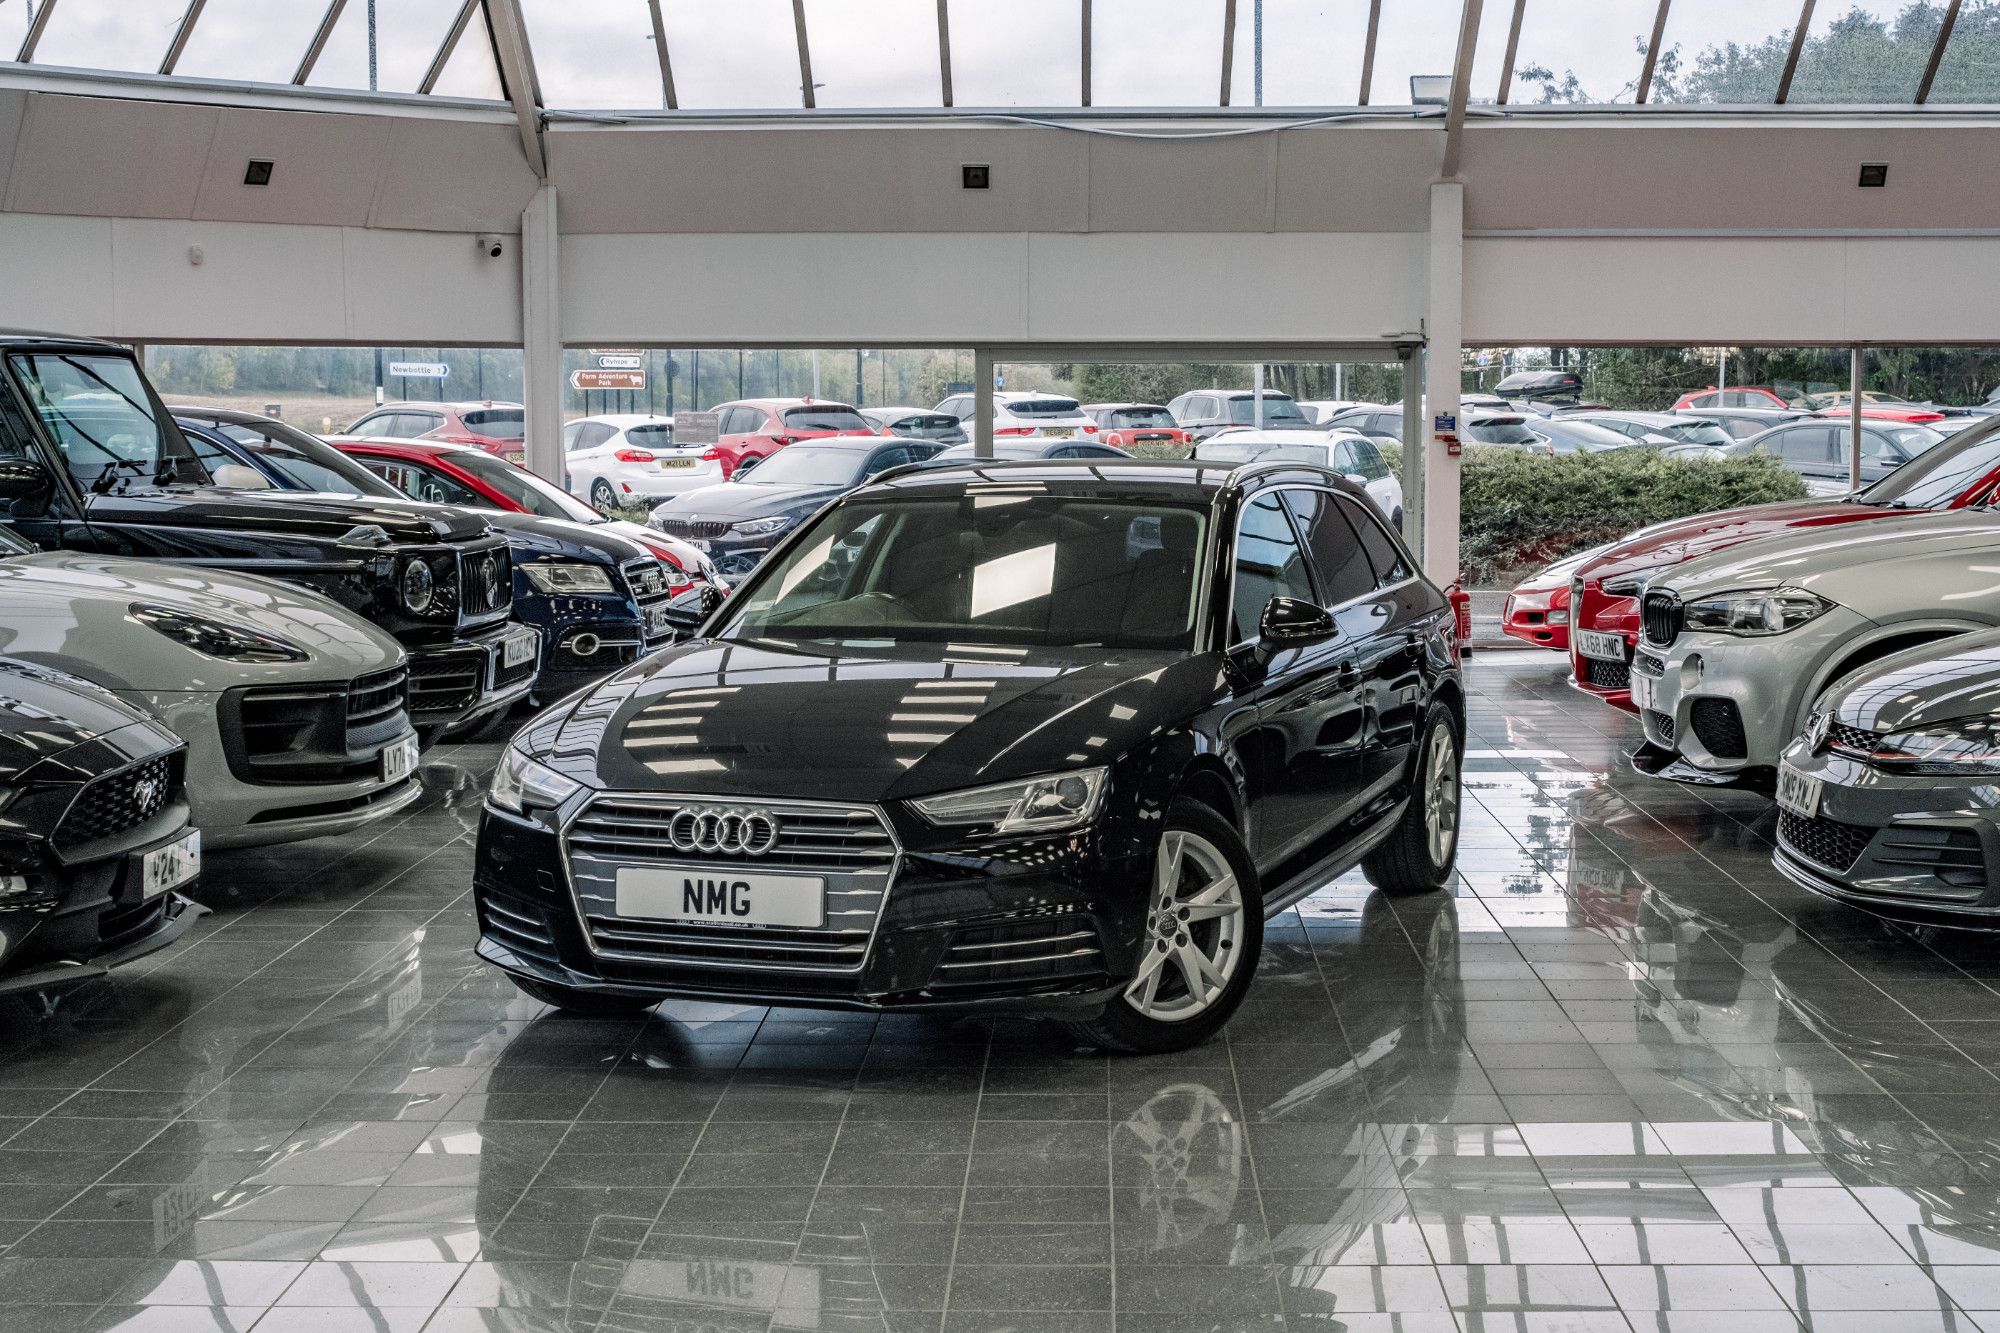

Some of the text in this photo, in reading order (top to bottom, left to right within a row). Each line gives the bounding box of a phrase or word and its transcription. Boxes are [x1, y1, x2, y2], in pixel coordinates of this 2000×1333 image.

[392, 366, 432, 374] Newbottle
[1602, 636, 1620, 657] HNC
[683, 878, 751, 916] NMG
